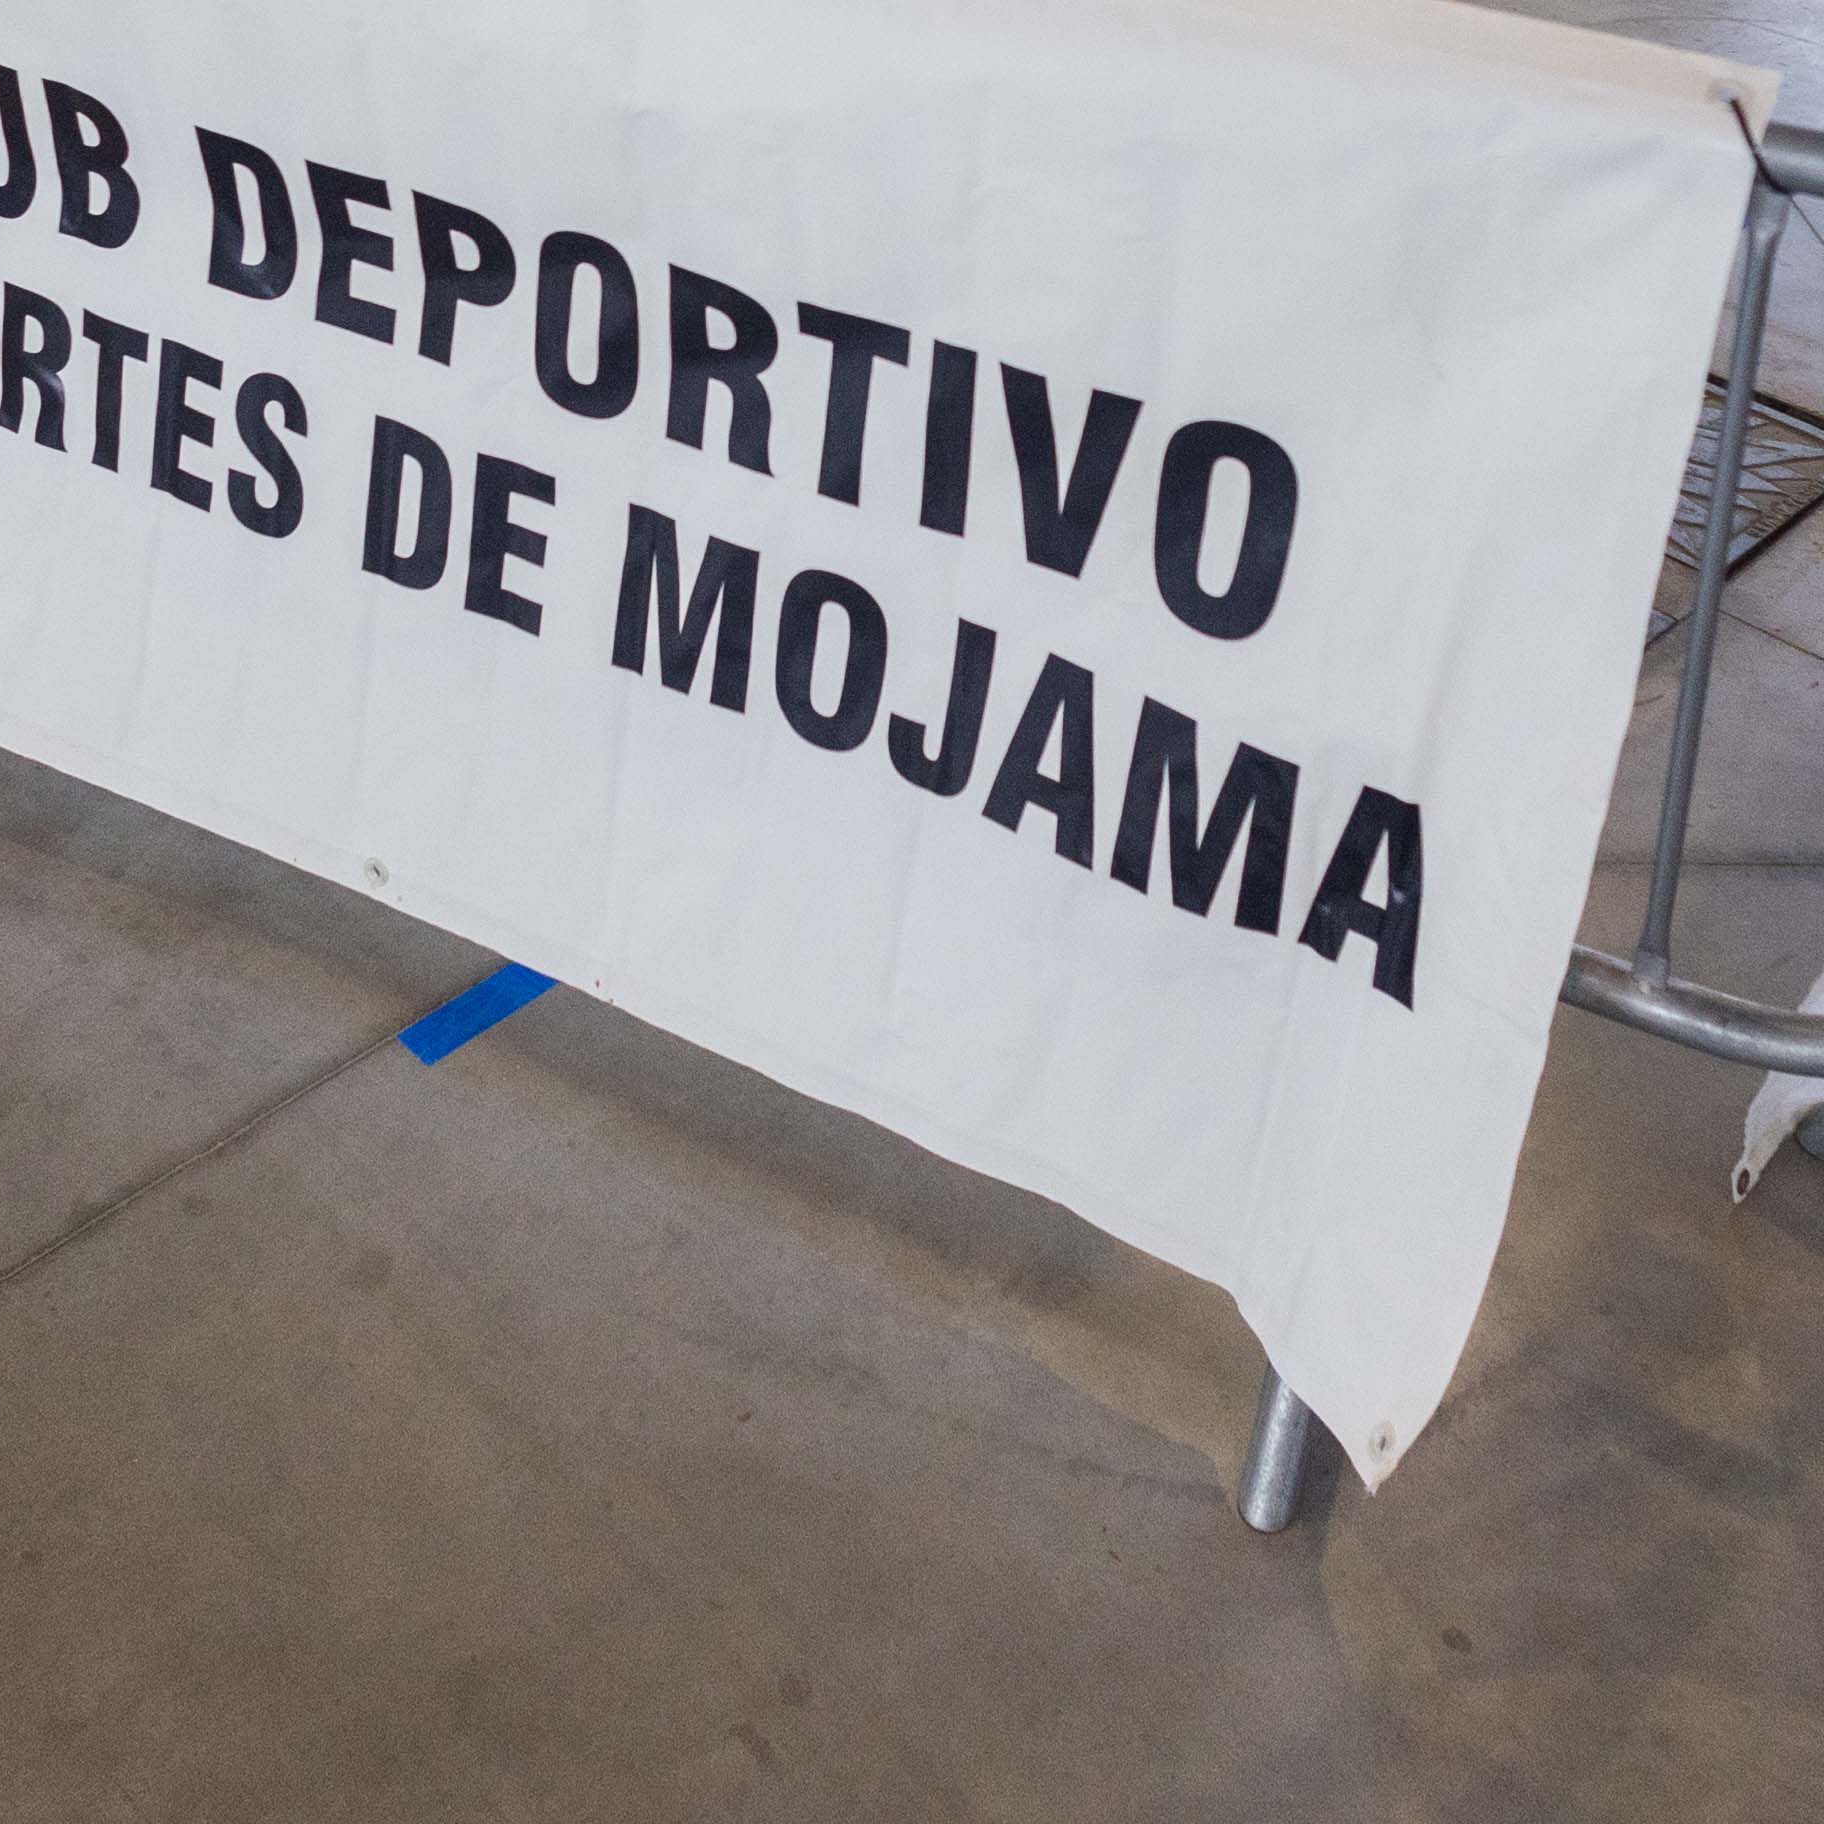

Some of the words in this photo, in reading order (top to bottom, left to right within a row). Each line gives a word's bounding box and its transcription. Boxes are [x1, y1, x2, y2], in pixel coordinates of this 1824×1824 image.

[194, 123, 1300, 643] DEPORTIVO
[360, 413, 558, 638] DE
[610, 502, 1425, 1012] MOJAMA
